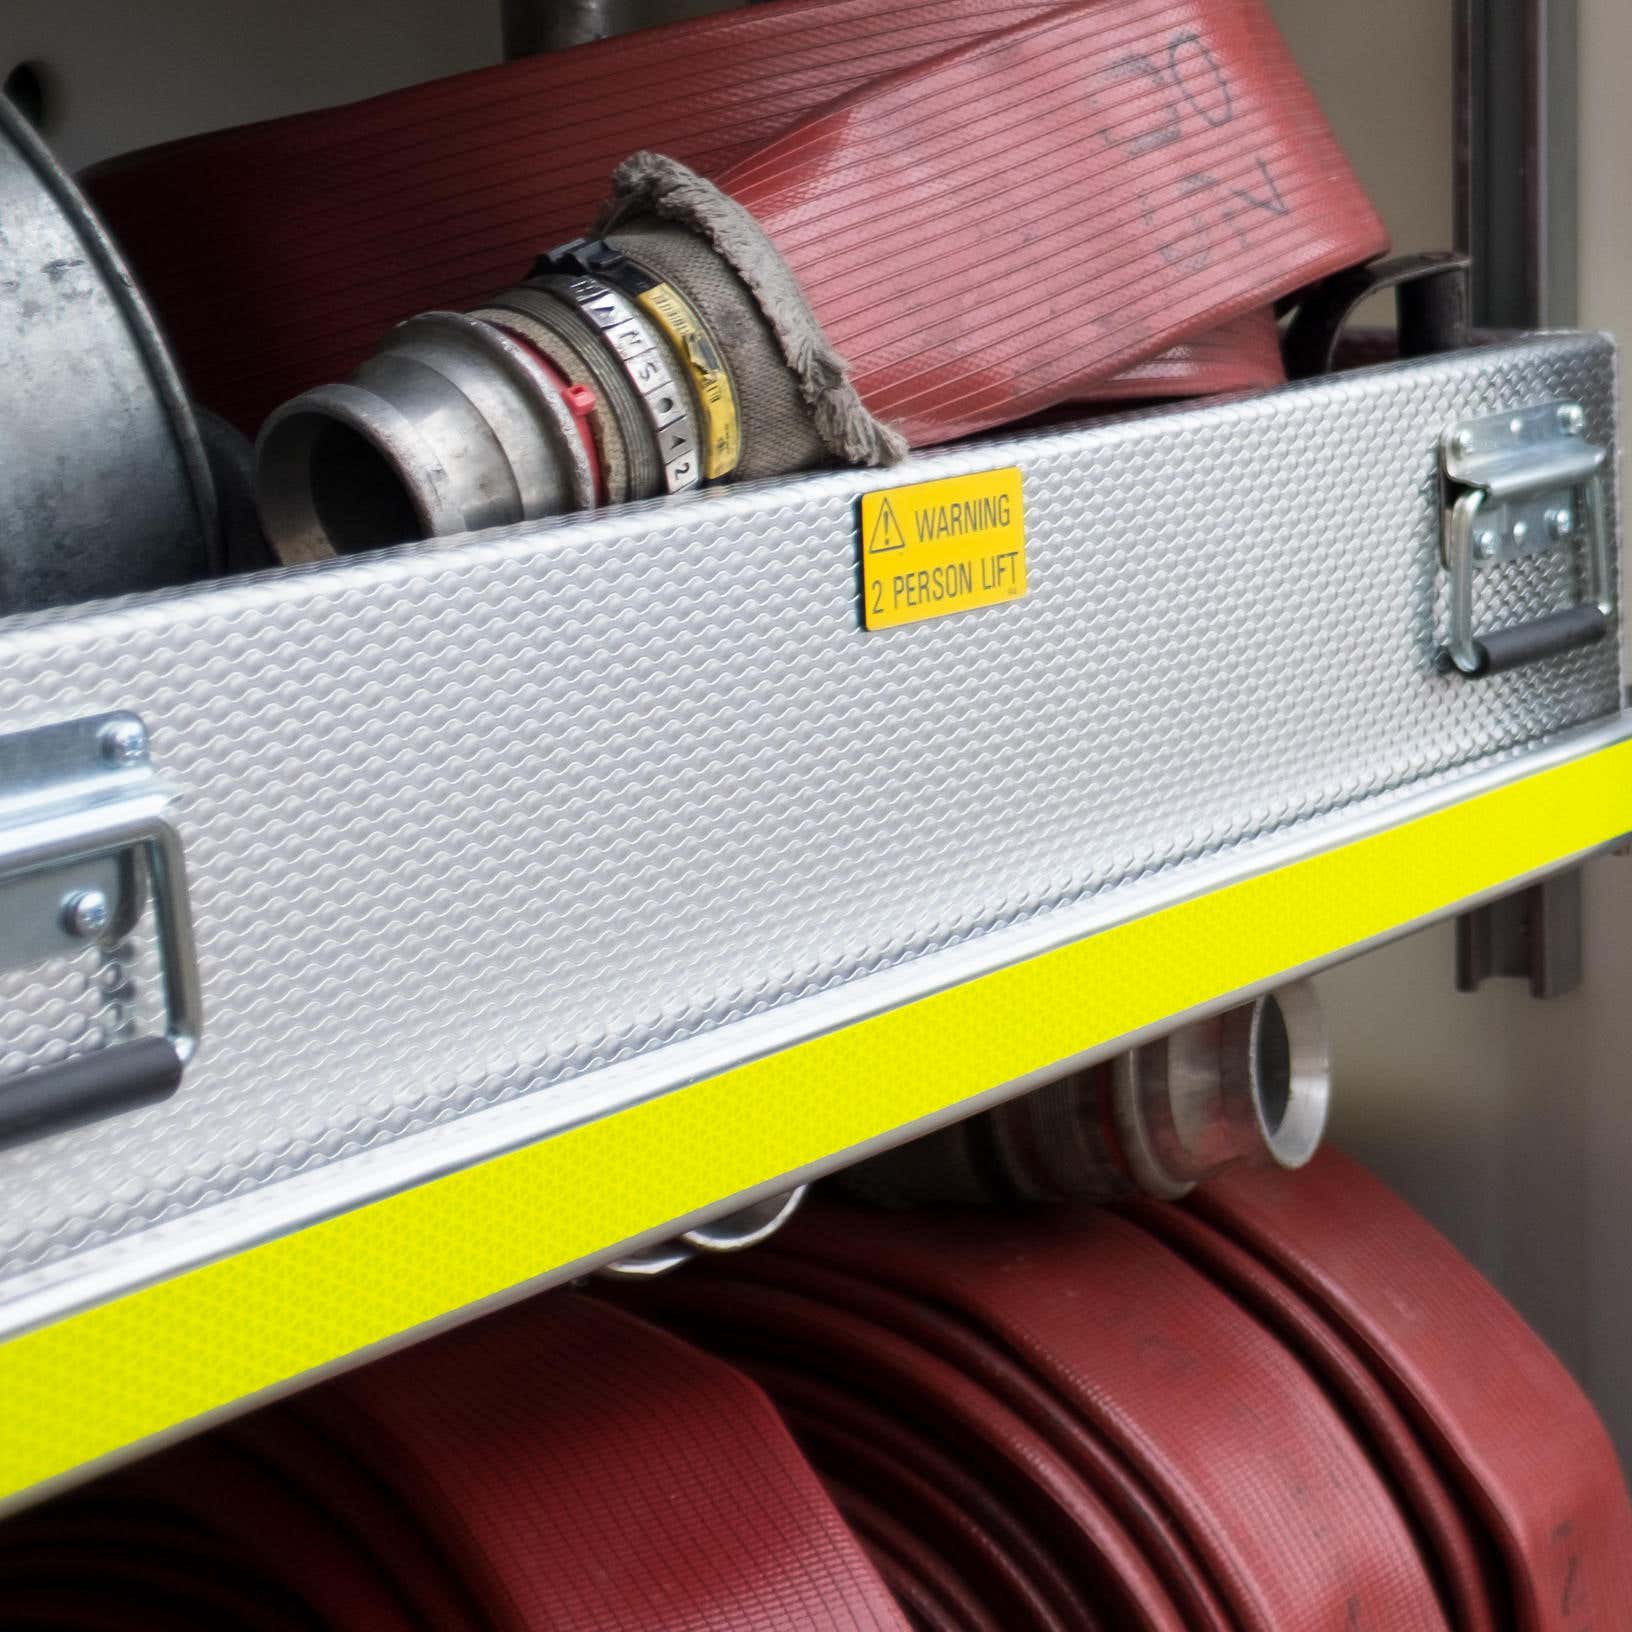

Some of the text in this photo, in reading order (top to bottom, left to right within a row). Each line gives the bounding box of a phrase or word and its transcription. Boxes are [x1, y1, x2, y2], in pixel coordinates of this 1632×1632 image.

[914, 493, 1010, 543] WARNING
[871, 551, 1019, 615] 2 PERSON LIFT
